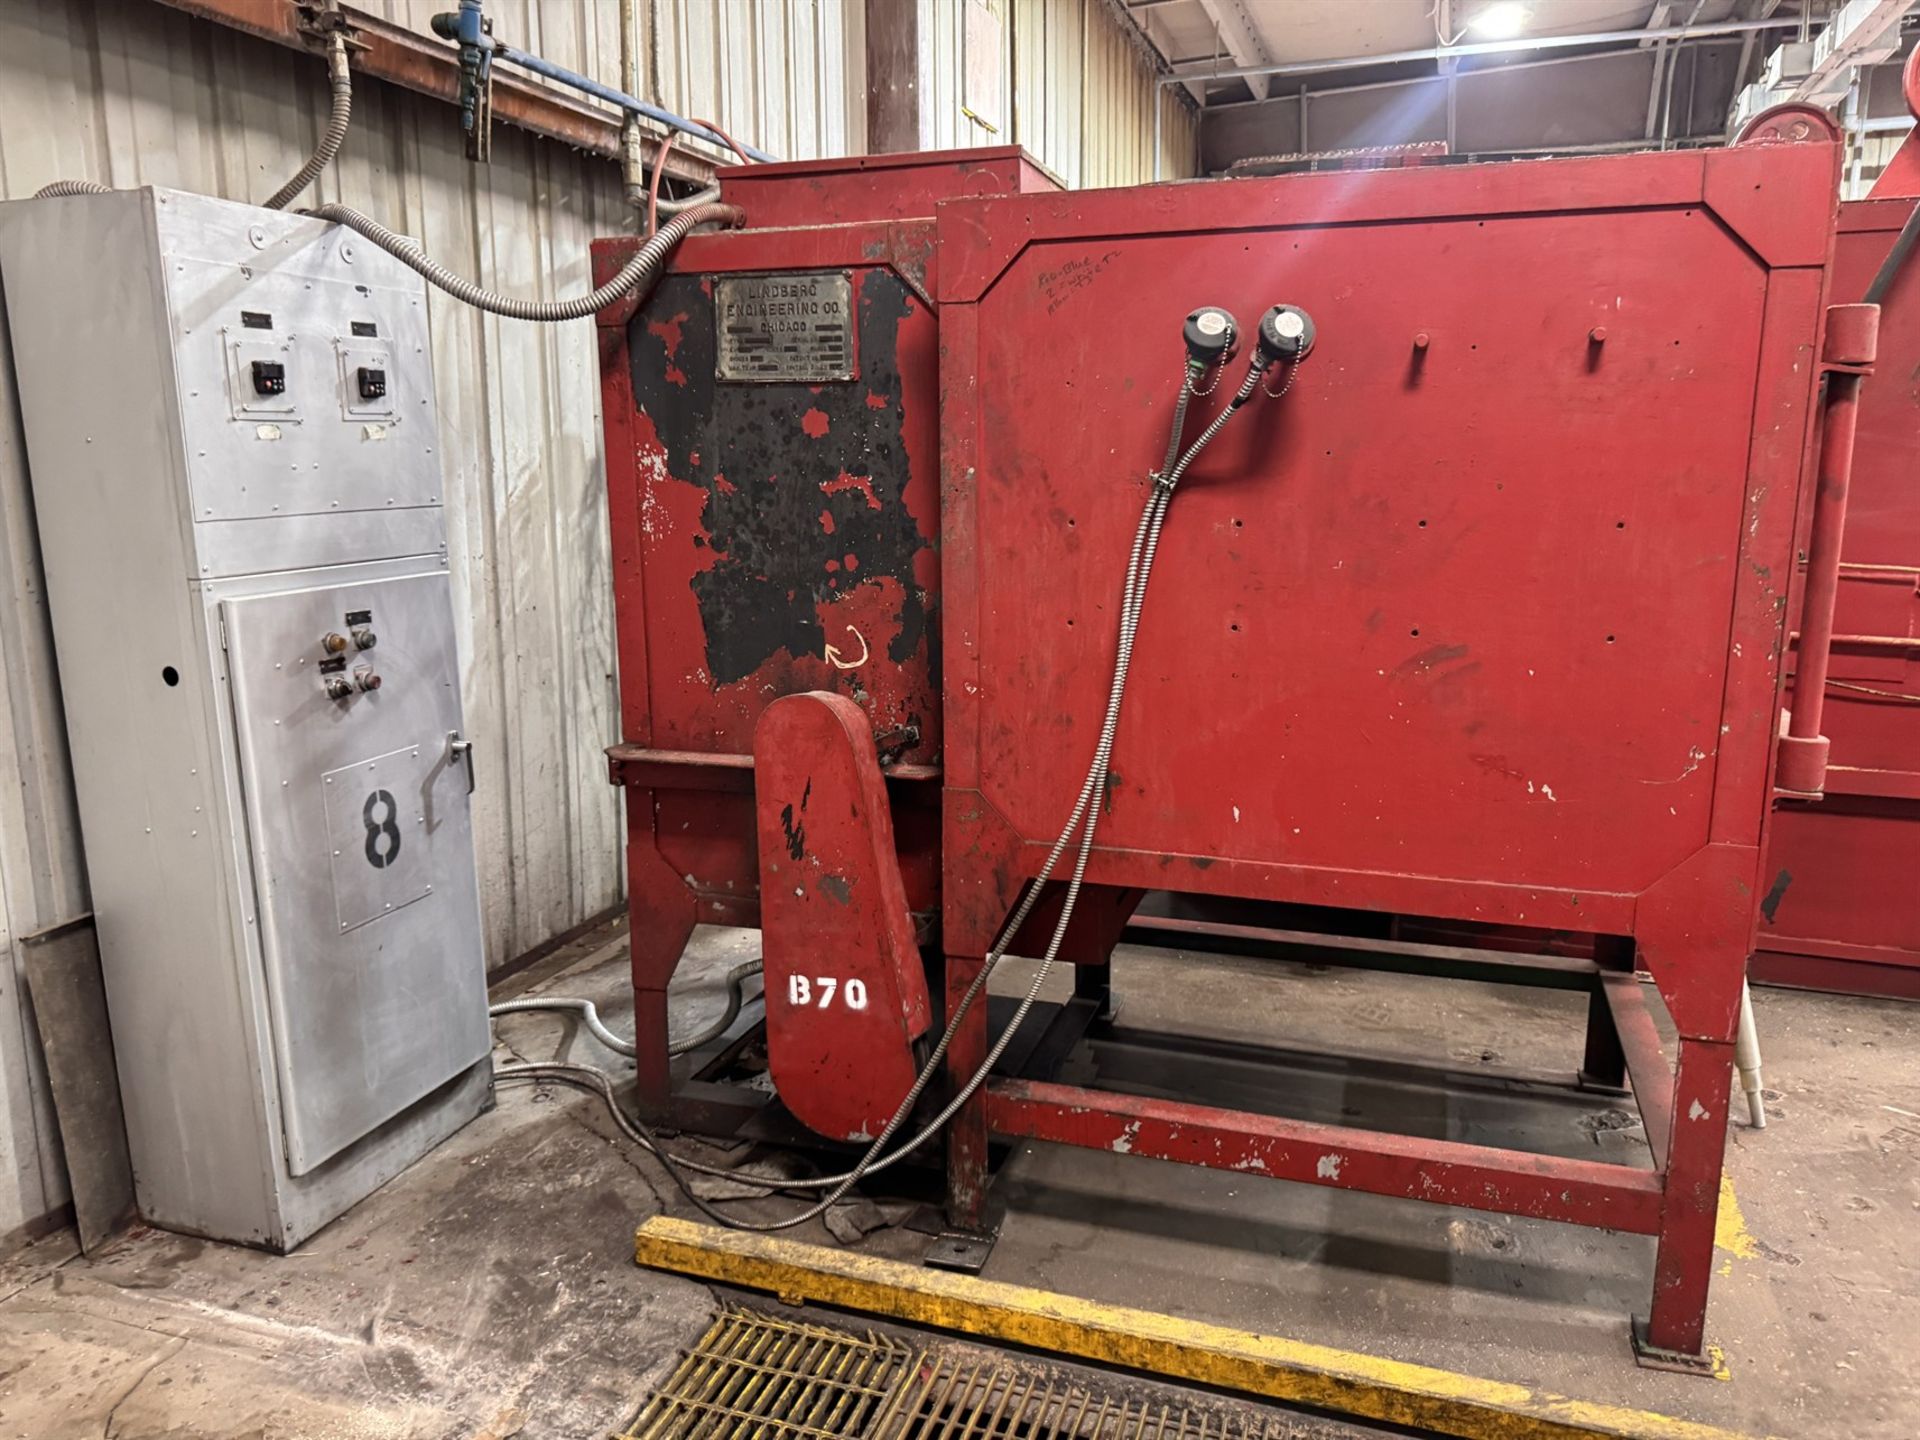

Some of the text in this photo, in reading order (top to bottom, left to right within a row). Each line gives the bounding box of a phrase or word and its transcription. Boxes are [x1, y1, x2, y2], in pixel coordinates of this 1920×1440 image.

[749, 284, 817, 299] LINDBERG
[727, 302, 818, 317] ENGINEERING
[760, 321, 807, 334] CHICAGO
[363, 789, 400, 869] 8
[789, 974, 868, 1010] B70
